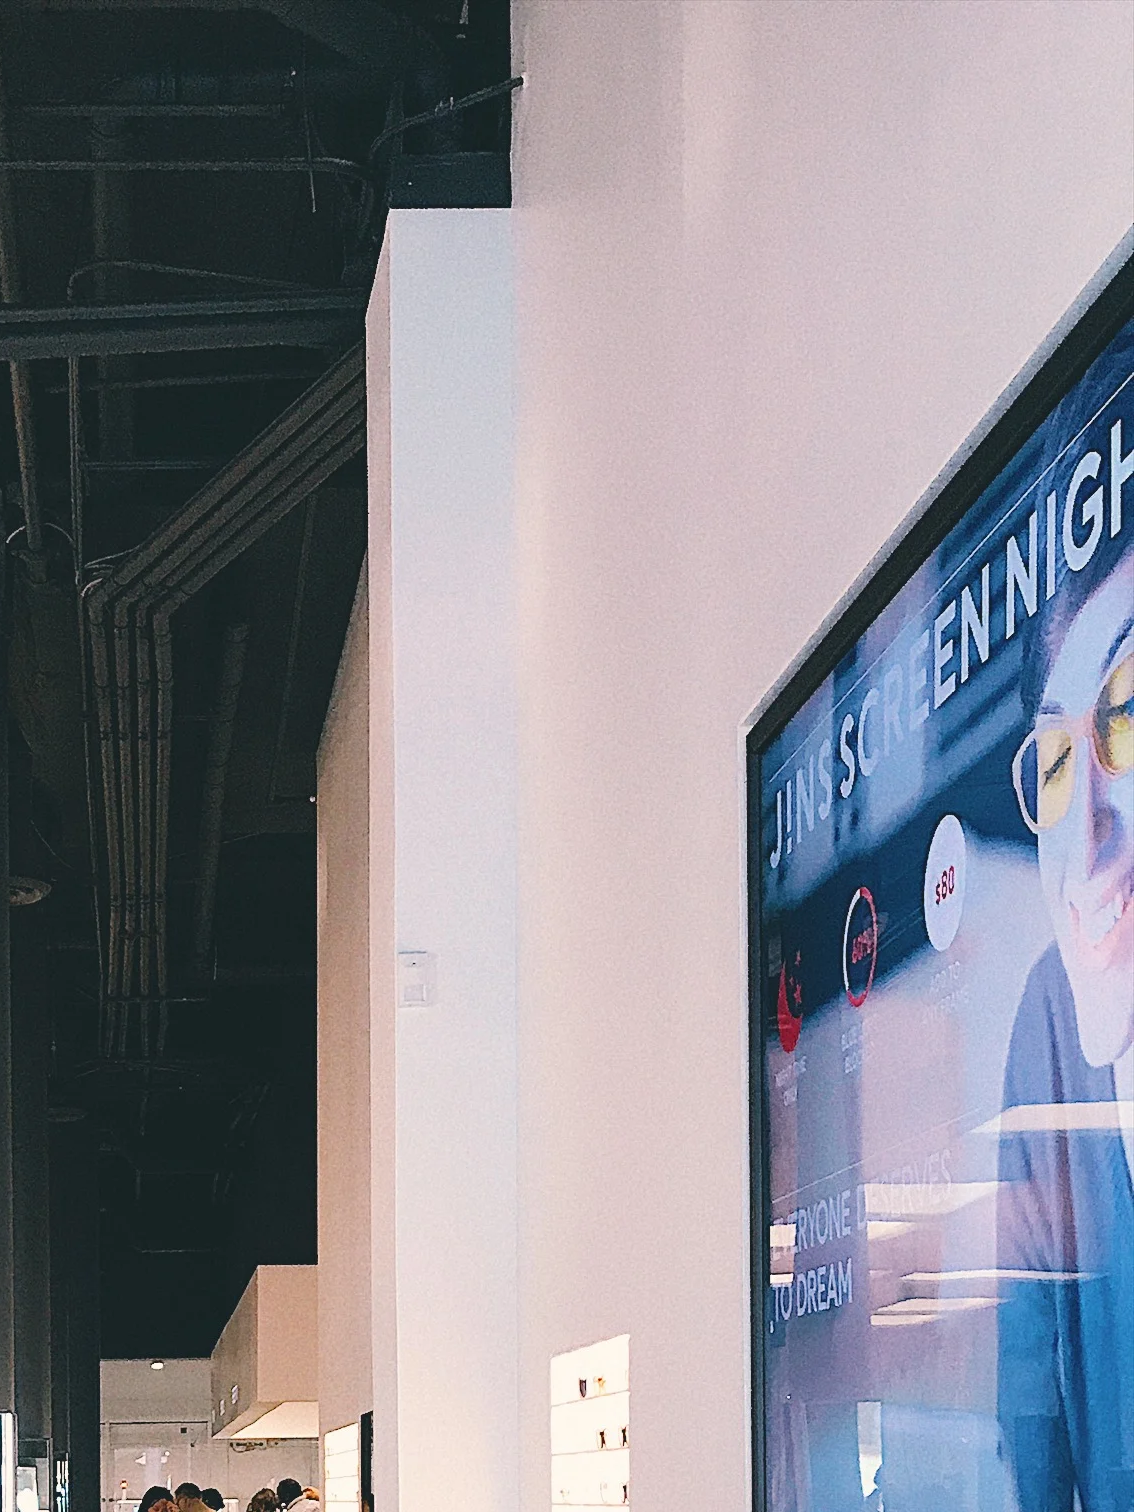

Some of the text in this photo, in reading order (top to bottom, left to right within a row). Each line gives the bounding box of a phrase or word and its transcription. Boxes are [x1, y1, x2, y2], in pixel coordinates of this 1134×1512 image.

[840, 562, 990, 799] SCREEN
[773, 1257, 853, 1321] TO DREAM
